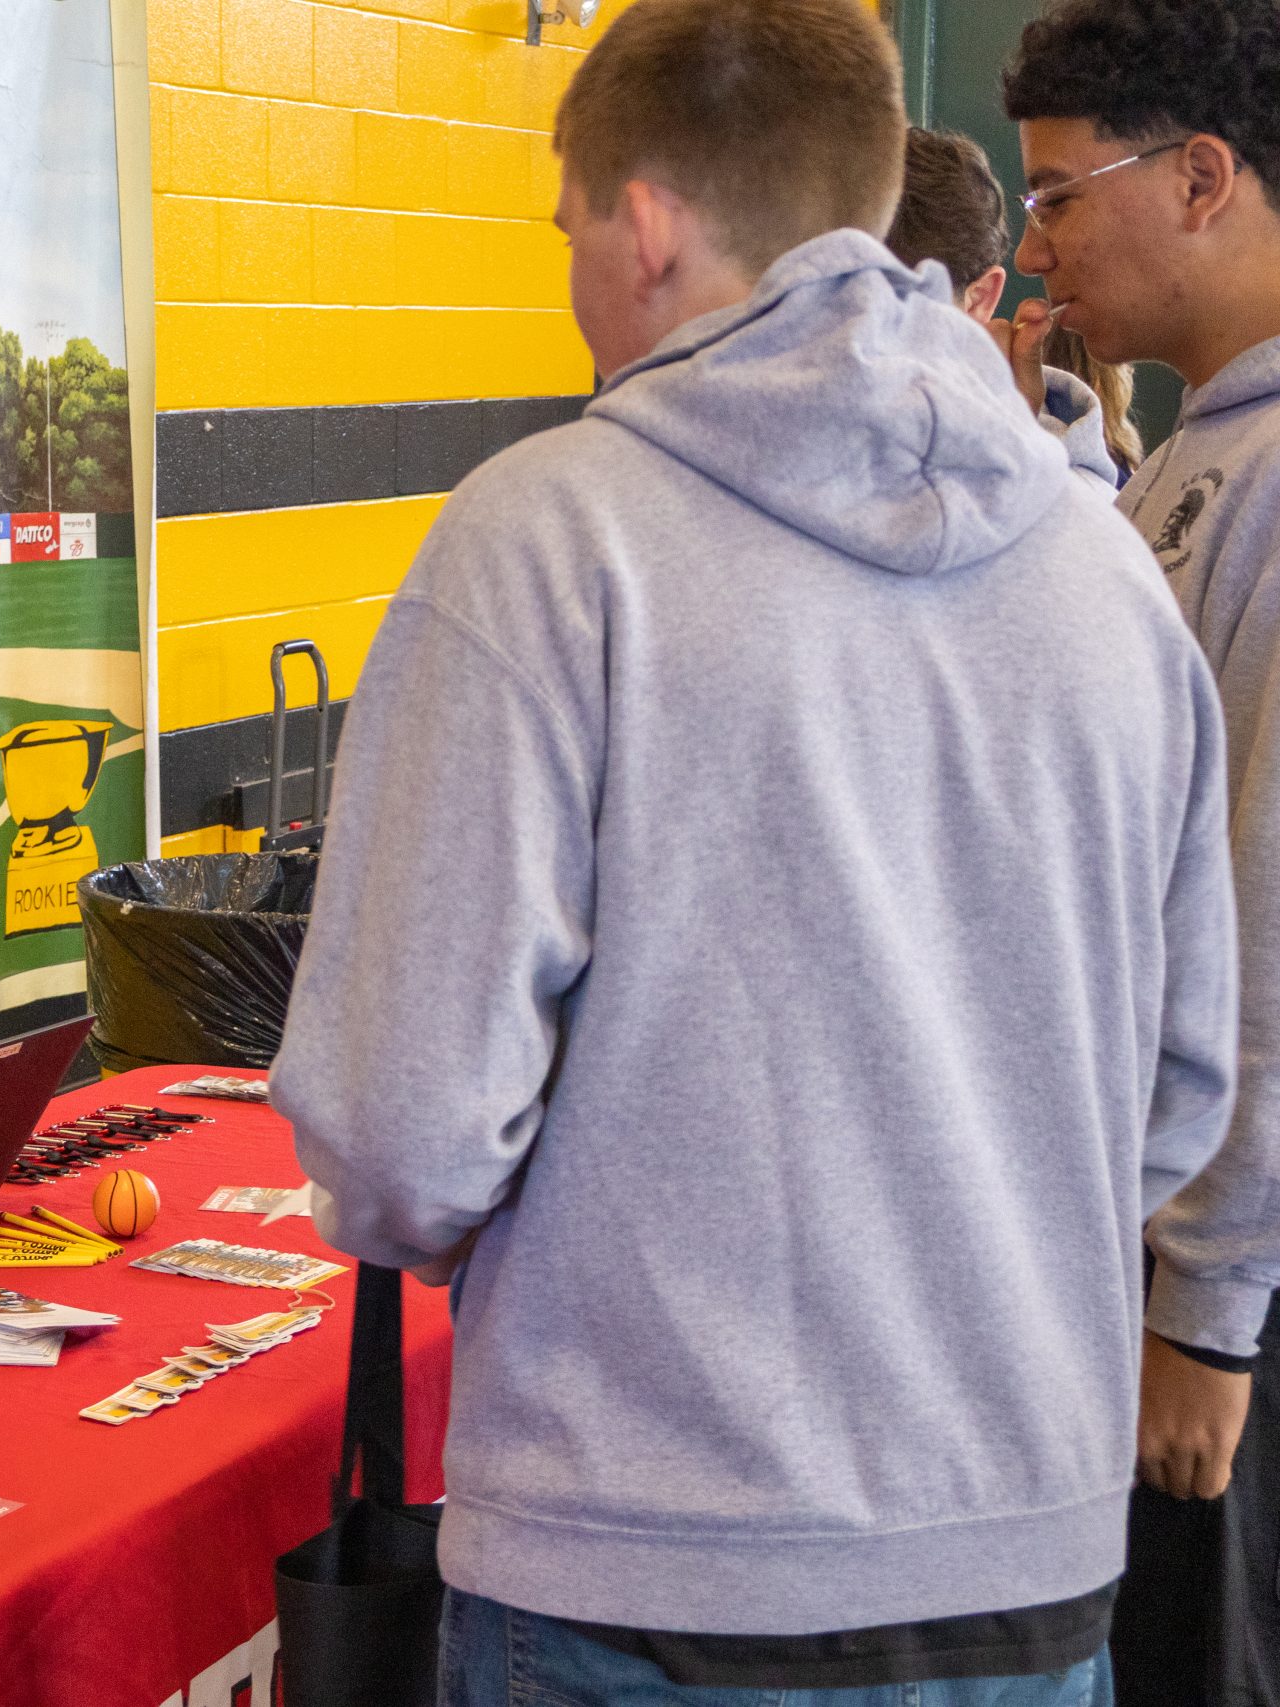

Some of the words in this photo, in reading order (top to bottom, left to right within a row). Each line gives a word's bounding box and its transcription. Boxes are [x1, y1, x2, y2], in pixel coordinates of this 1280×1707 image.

[16, 525, 53, 544] DATTCO
[14, 881, 79, 915] ROOKIE
[30, 1241, 68, 1252] DATTCO
